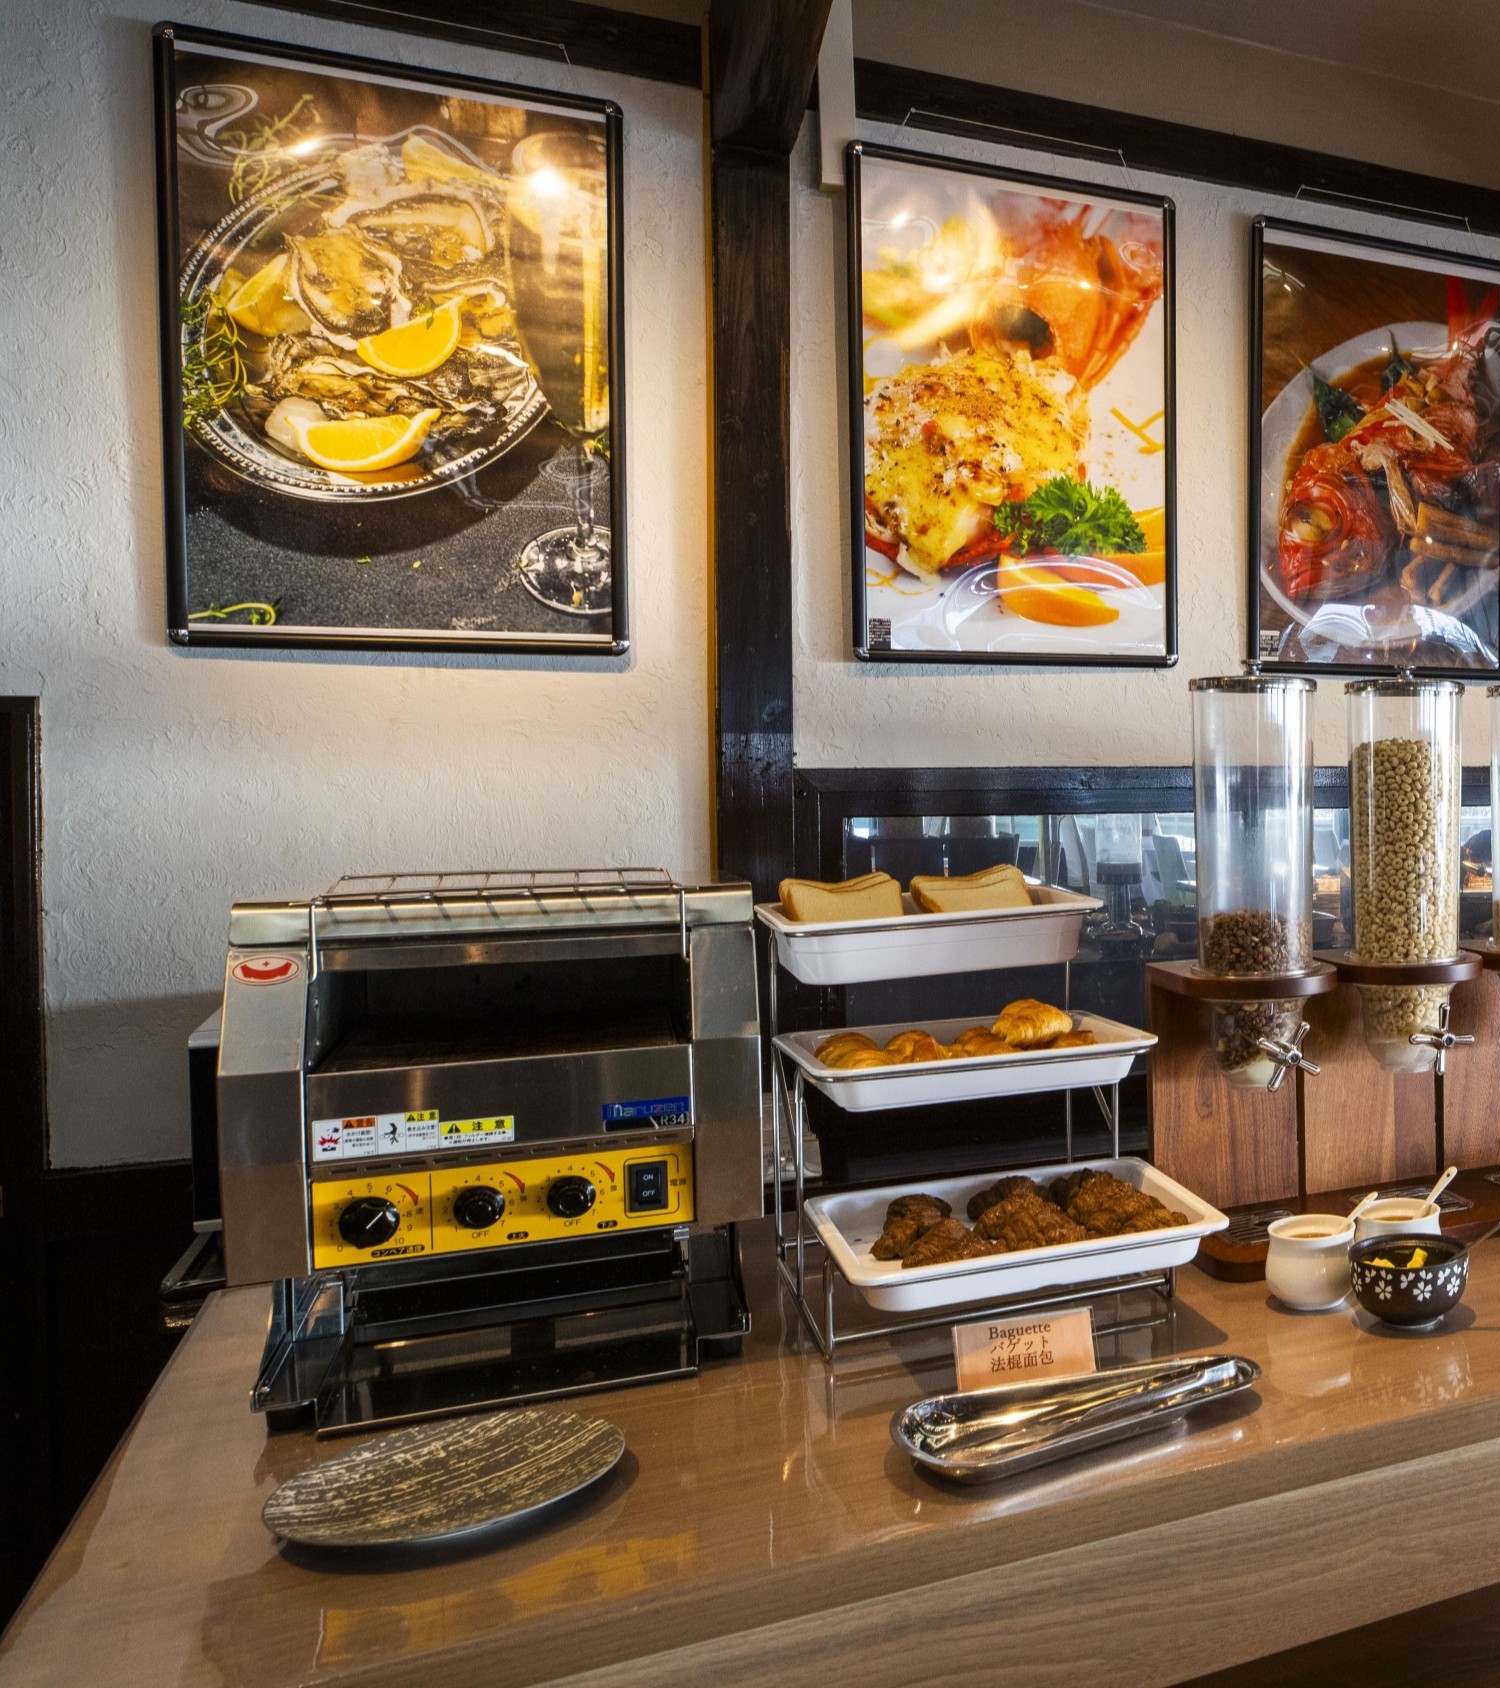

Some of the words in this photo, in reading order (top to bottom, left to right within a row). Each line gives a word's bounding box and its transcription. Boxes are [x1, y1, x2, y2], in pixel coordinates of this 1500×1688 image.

[416, 1111, 437, 1122] 注意
[472, 1119, 505, 1131] 注意
[642, 1189, 656, 1197] OFF
[563, 1219, 581, 1227] OFF
[471, 1230, 490, 1239] OFF
[394, 1237, 404, 1245] 10
[988, 1322, 1051, 1341] Baguette
[990, 1336, 1050, 1355] バゲット
[990, 1350, 1054, 1373] 法棍面包
